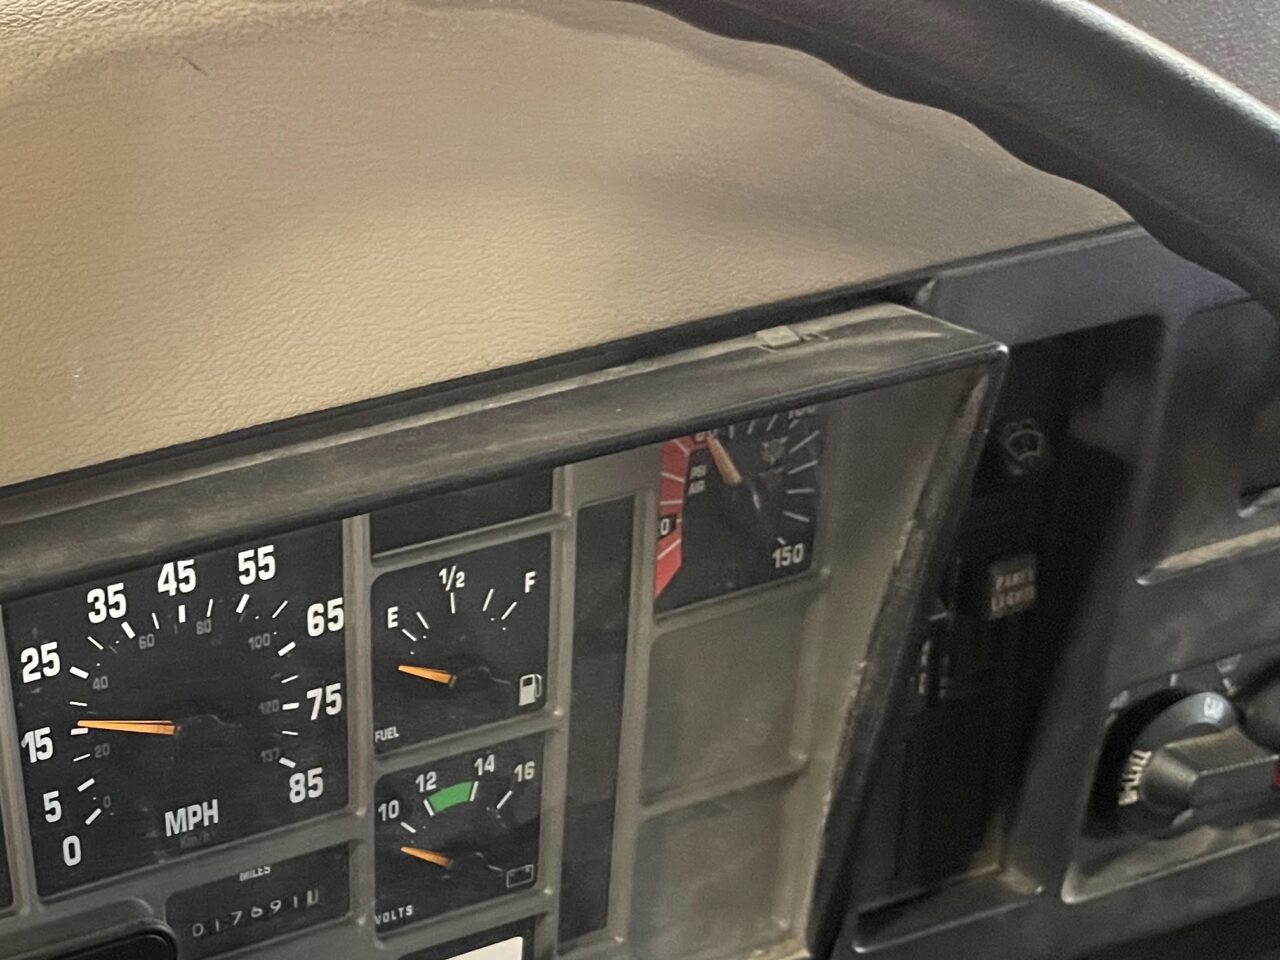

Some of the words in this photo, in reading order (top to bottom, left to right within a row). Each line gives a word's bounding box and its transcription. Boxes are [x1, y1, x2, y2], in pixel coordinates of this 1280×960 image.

[660, 518, 670, 536] 0
[237, 544, 276, 586] 55
[772, 543, 804, 568] 150
[157, 558, 197, 597] 45
[524, 571, 536, 593] F
[86, 582, 126, 624] 35
[306, 597, 345, 637] 65
[387, 606, 399, 629] E
[138, 632, 156, 650] 60
[247, 632, 272, 651] 100
[20, 641, 61, 684] 25
[91, 675, 110, 692] 40
[306, 682, 342, 721] 75
[21, 726, 54, 764] 15
[374, 726, 400, 743] FUEL
[93, 742, 111, 760] 20
[474, 754, 495, 776] 14
[514, 761, 535, 782] 16
[288, 766, 324, 804] 85
[415, 771, 438, 793] 12
[43, 790, 62, 823] 5
[164, 798, 219, 837] MPH
[377, 799, 400, 822] 10
[62, 835, 82, 867] 0
[239, 866, 271, 882] MILES
[374, 904, 413, 925] VOLTS
